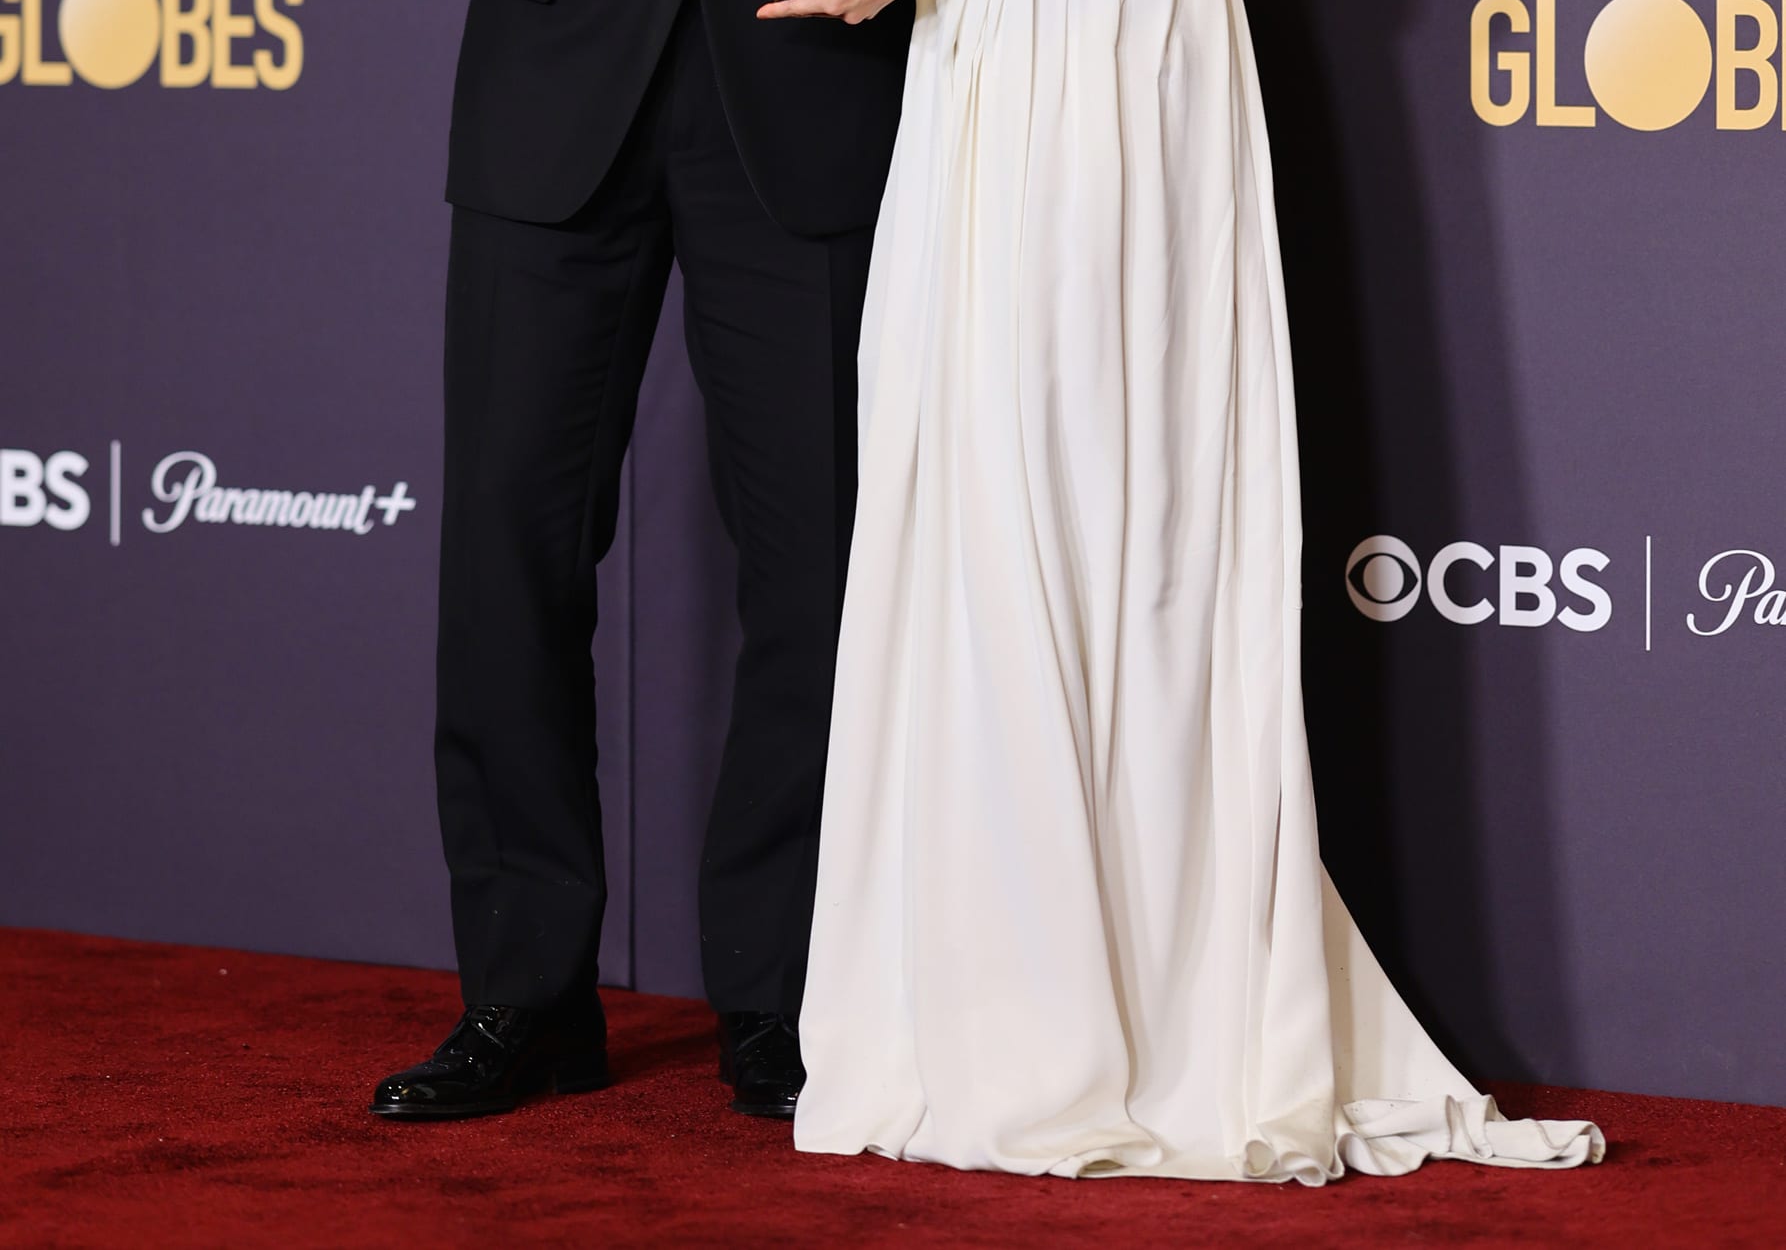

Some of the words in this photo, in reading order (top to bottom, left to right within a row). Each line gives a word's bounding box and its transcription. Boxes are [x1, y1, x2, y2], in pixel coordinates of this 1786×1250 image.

[142, 451, 416, 535] Paramount+
[1427, 541, 1613, 632] CBS
[1686, 549, 1786, 636] Pa
